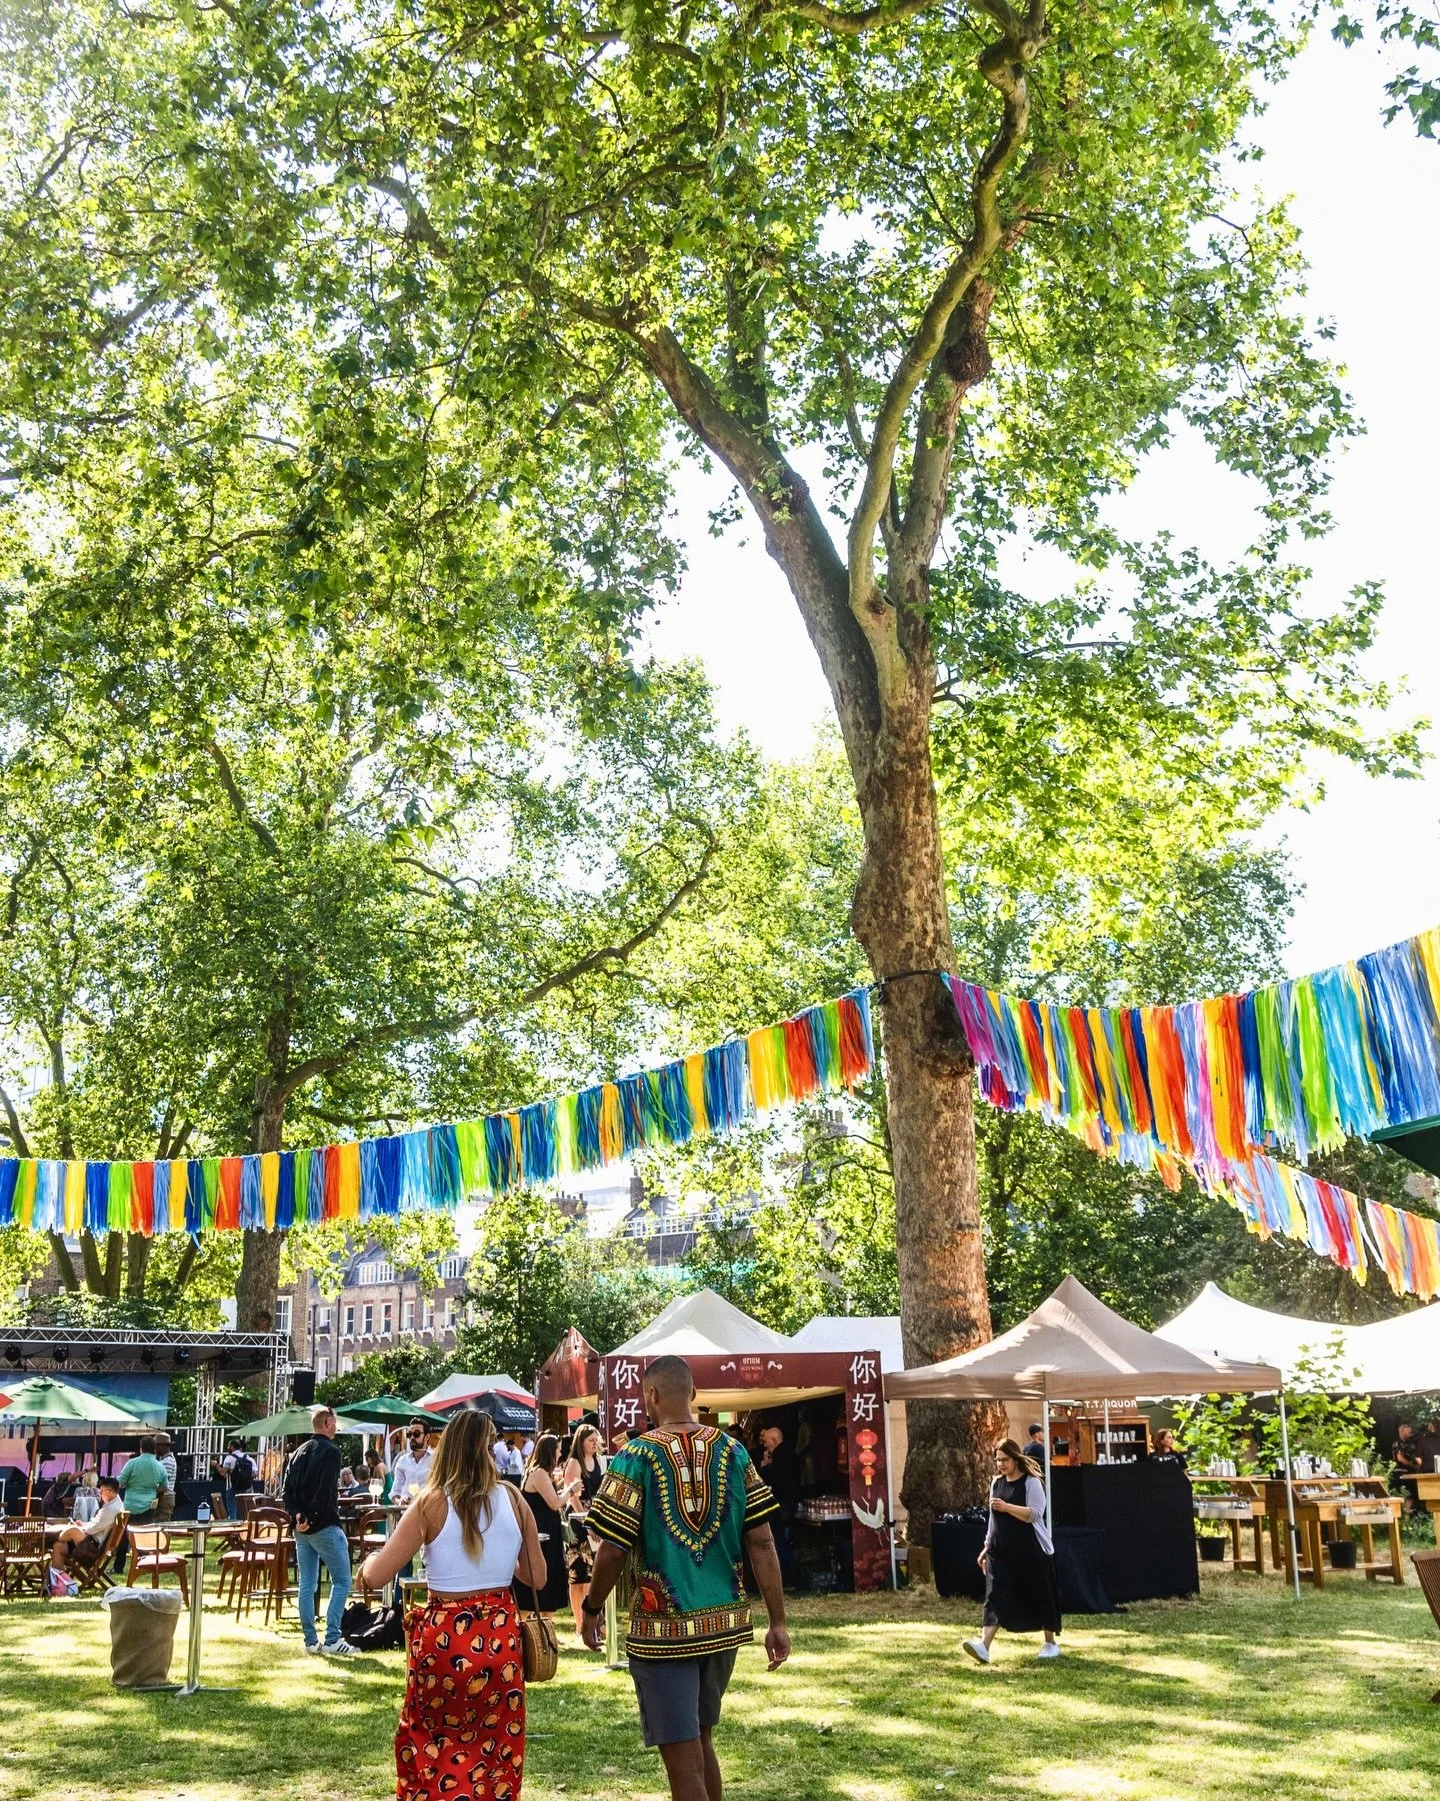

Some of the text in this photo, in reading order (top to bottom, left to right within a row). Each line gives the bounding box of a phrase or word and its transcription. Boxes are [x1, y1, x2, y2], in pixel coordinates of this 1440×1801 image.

[611, 1359, 642, 1428] 你好
[849, 1355, 880, 1422] 你好
[1084, 1399, 1137, 1409] T.T.IQUOR
